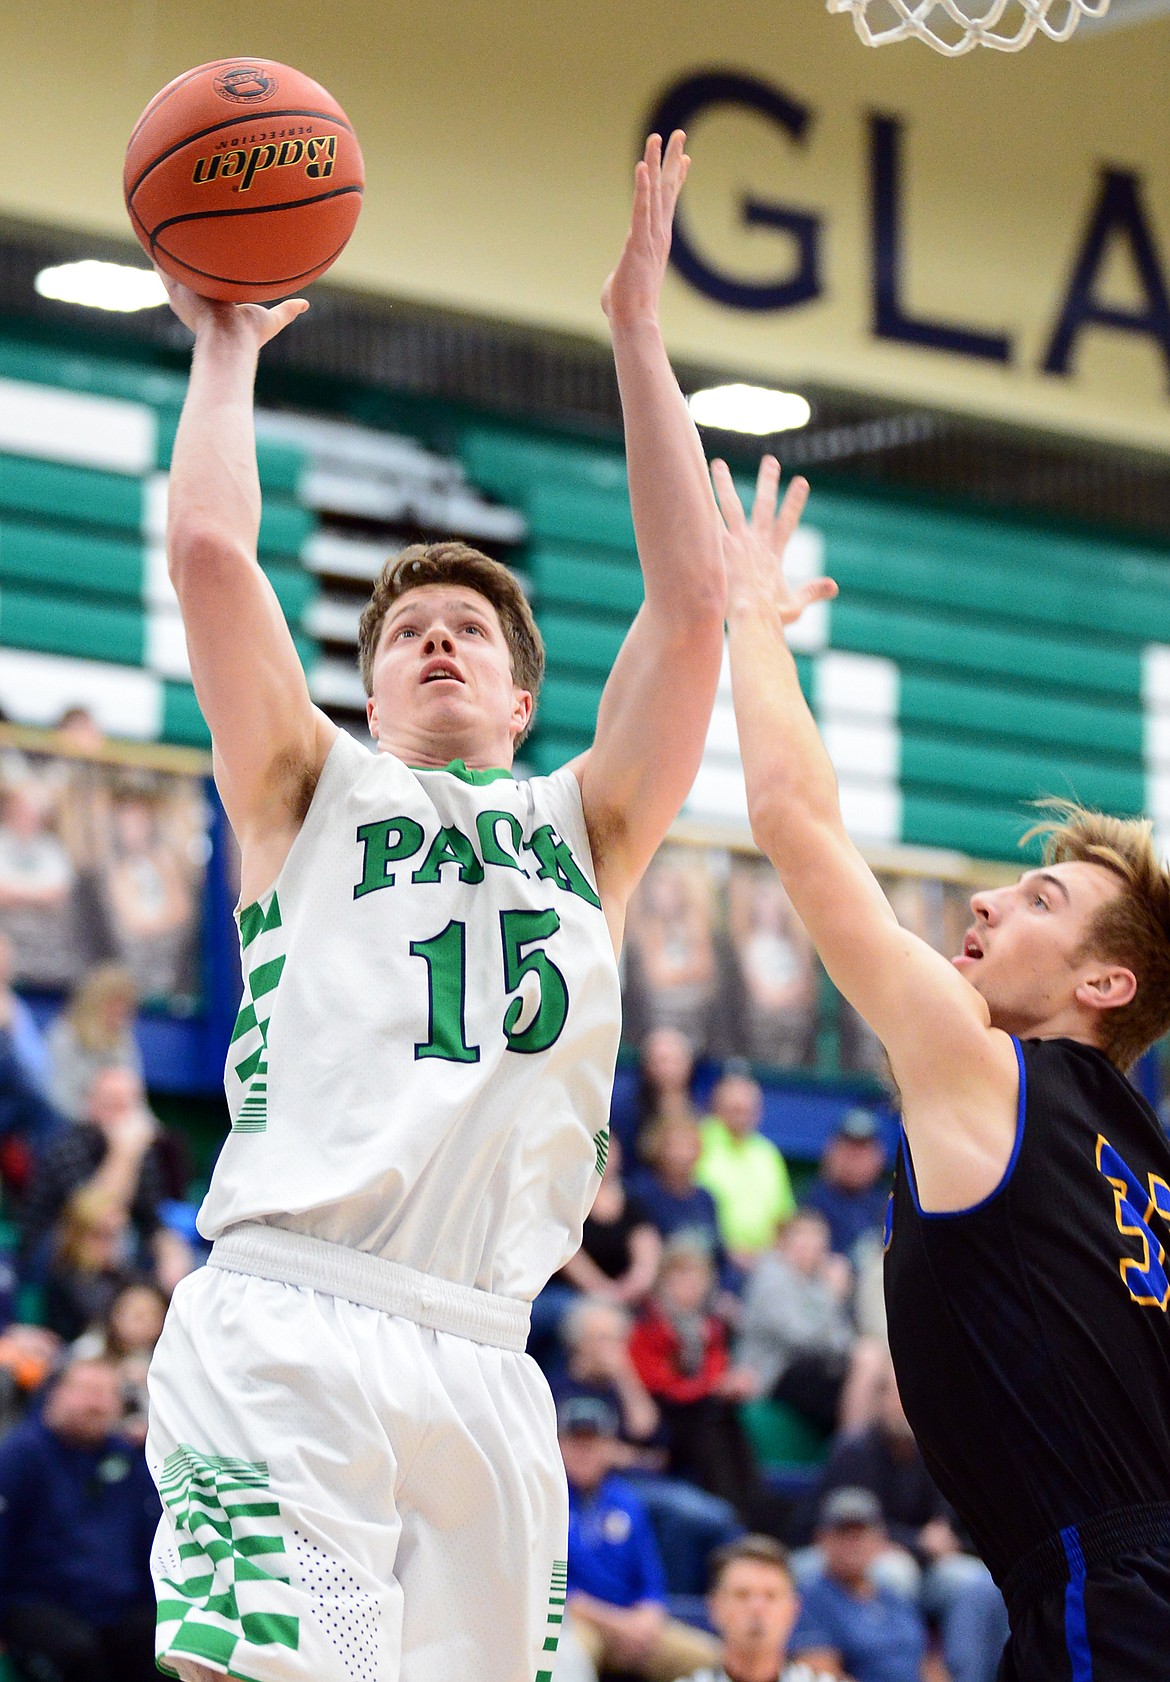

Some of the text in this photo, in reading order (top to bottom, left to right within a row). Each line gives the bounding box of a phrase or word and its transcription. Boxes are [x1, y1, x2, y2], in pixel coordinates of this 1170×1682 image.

[192, 135, 337, 192] Baden
[218, 126, 313, 148] PERFECTION
[353, 810, 602, 911] PACK
[409, 908, 569, 1063] 15
